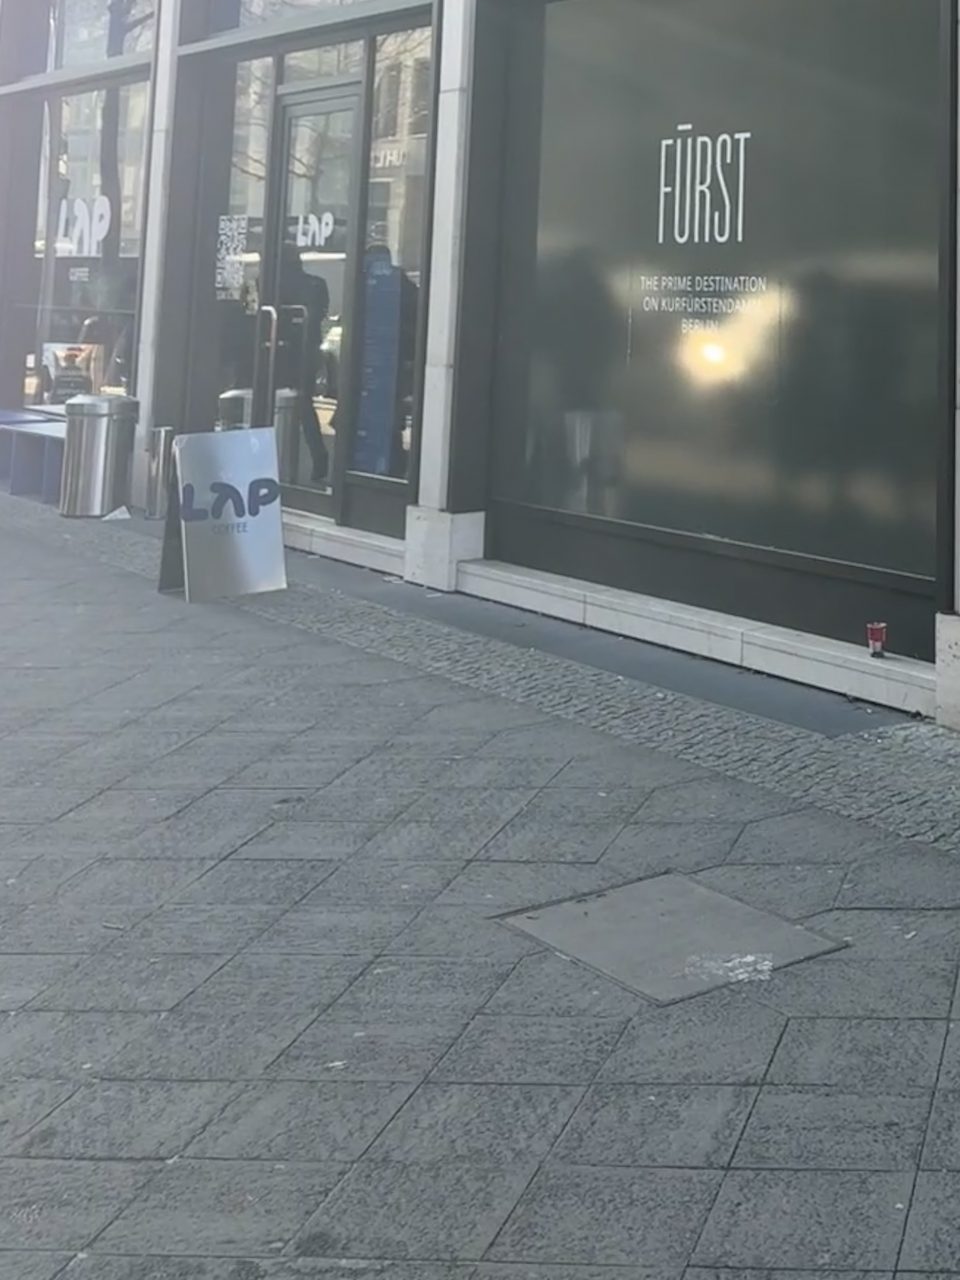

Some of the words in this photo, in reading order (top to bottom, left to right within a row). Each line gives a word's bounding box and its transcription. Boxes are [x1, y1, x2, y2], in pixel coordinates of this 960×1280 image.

[640, 276, 659, 291] THE
[661, 276, 692, 291] PRIME
[695, 275, 767, 292] DESTINATION
[643, 297, 659, 312] ON
[182, 478, 280, 521] LAP
